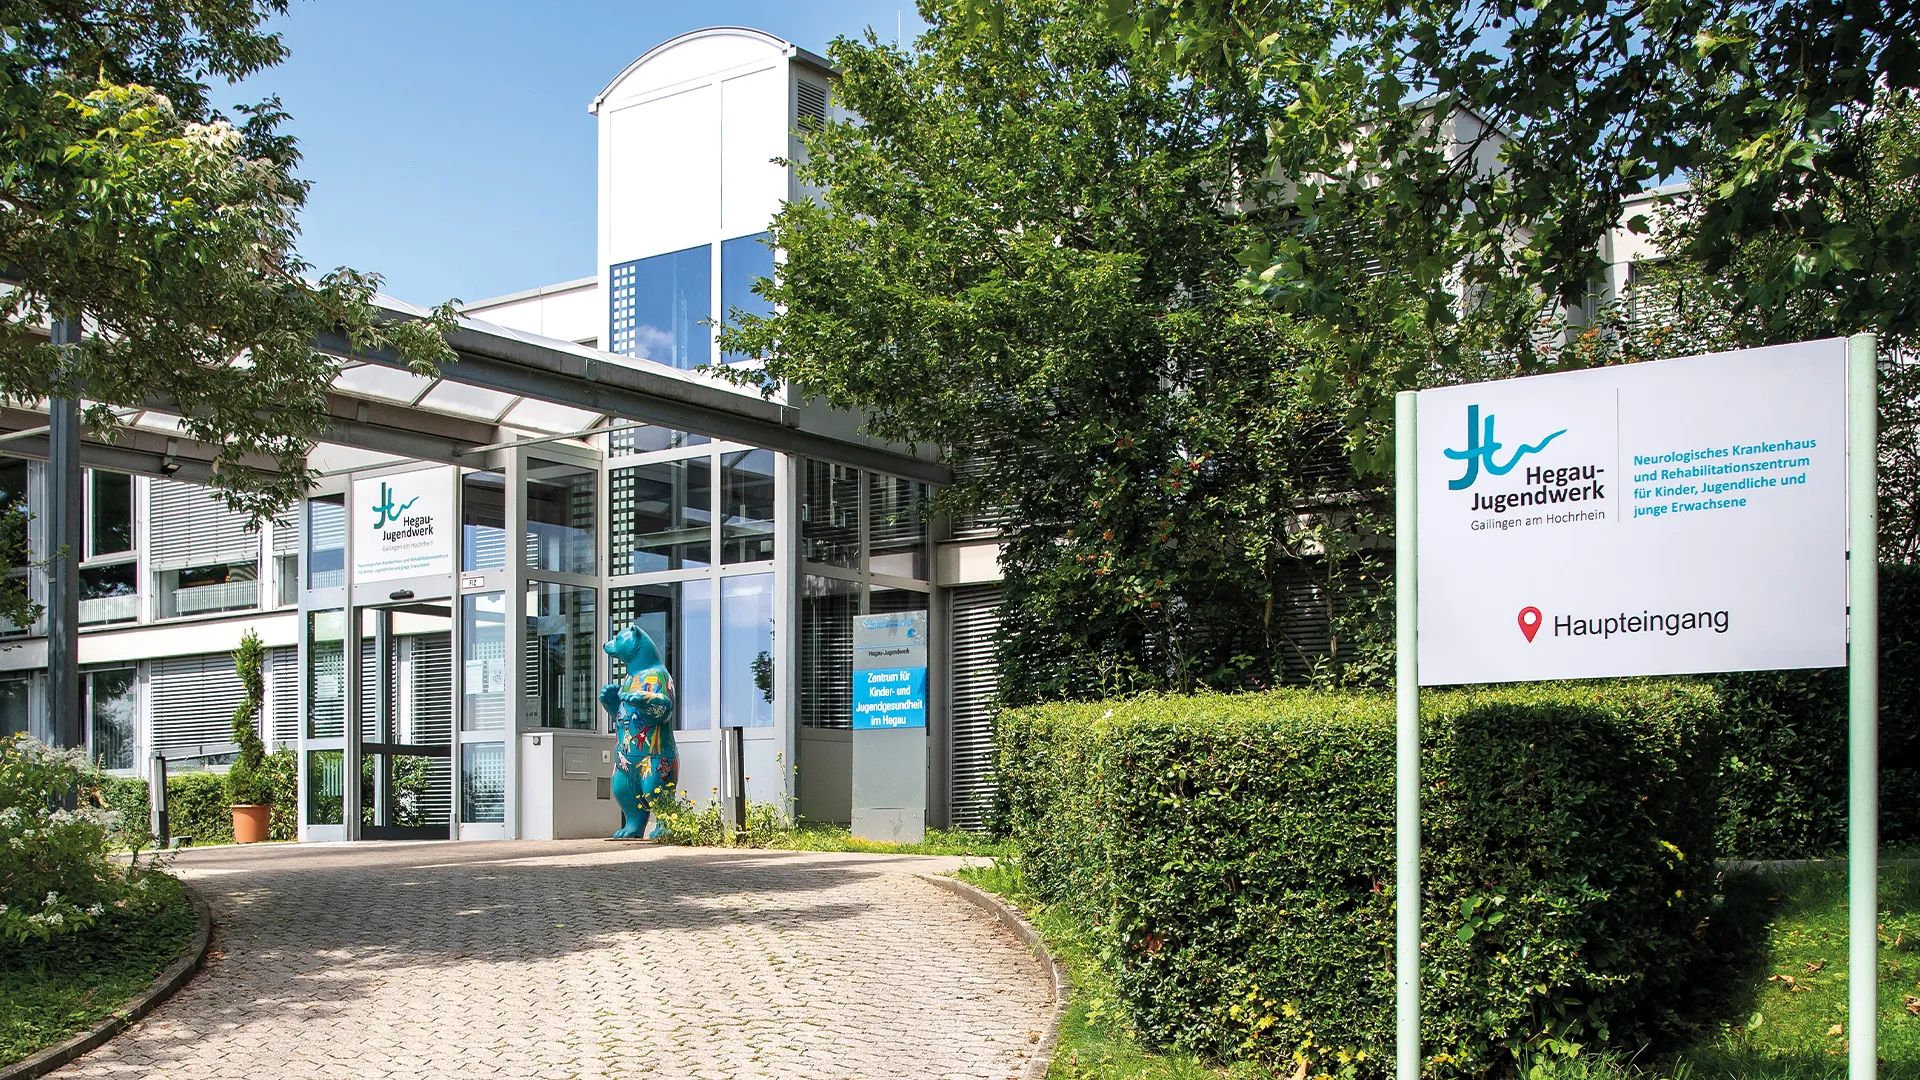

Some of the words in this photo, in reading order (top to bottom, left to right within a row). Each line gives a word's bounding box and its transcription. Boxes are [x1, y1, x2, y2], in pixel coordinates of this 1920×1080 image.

[1634, 447, 1728, 466] Neurologisches
[1732, 437, 1816, 456] Krankenhaus
[1526, 464, 1604, 487] Hegau-
[1634, 470, 1658, 482] und
[1661, 456, 1810, 480] Rehabilitationszentrum
[1471, 480, 1605, 513] Jugendwerk
[1634, 487, 1652, 499] für
[1655, 484, 1699, 497] Kinder,
[1702, 476, 1776, 495] Jugendliche
[1780, 472, 1806, 486] und
[1633, 504, 1668, 519] junge
[1671, 497, 1747, 513] Erwachsene
[403, 516, 433, 528] Hegau-
[1471, 517, 1522, 531] Gailingen
[1526, 516, 1543, 526] am
[1546, 509, 1605, 524] Hochrhein
[382, 524, 433, 542] Jugendwerk
[1554, 610, 1729, 640] Haupteingang
[868, 648, 910, 657] Hegau-Jugendwerk
[867, 672, 898, 683] Zentrum
[900, 670, 910, 681] für
[869, 687, 895, 697] Kinder-
[896, 685, 910, 696] und
[856, 699, 923, 714] Jugendgesundheit
[871, 716, 881, 726] im
[882, 715, 906, 727] Hegau
